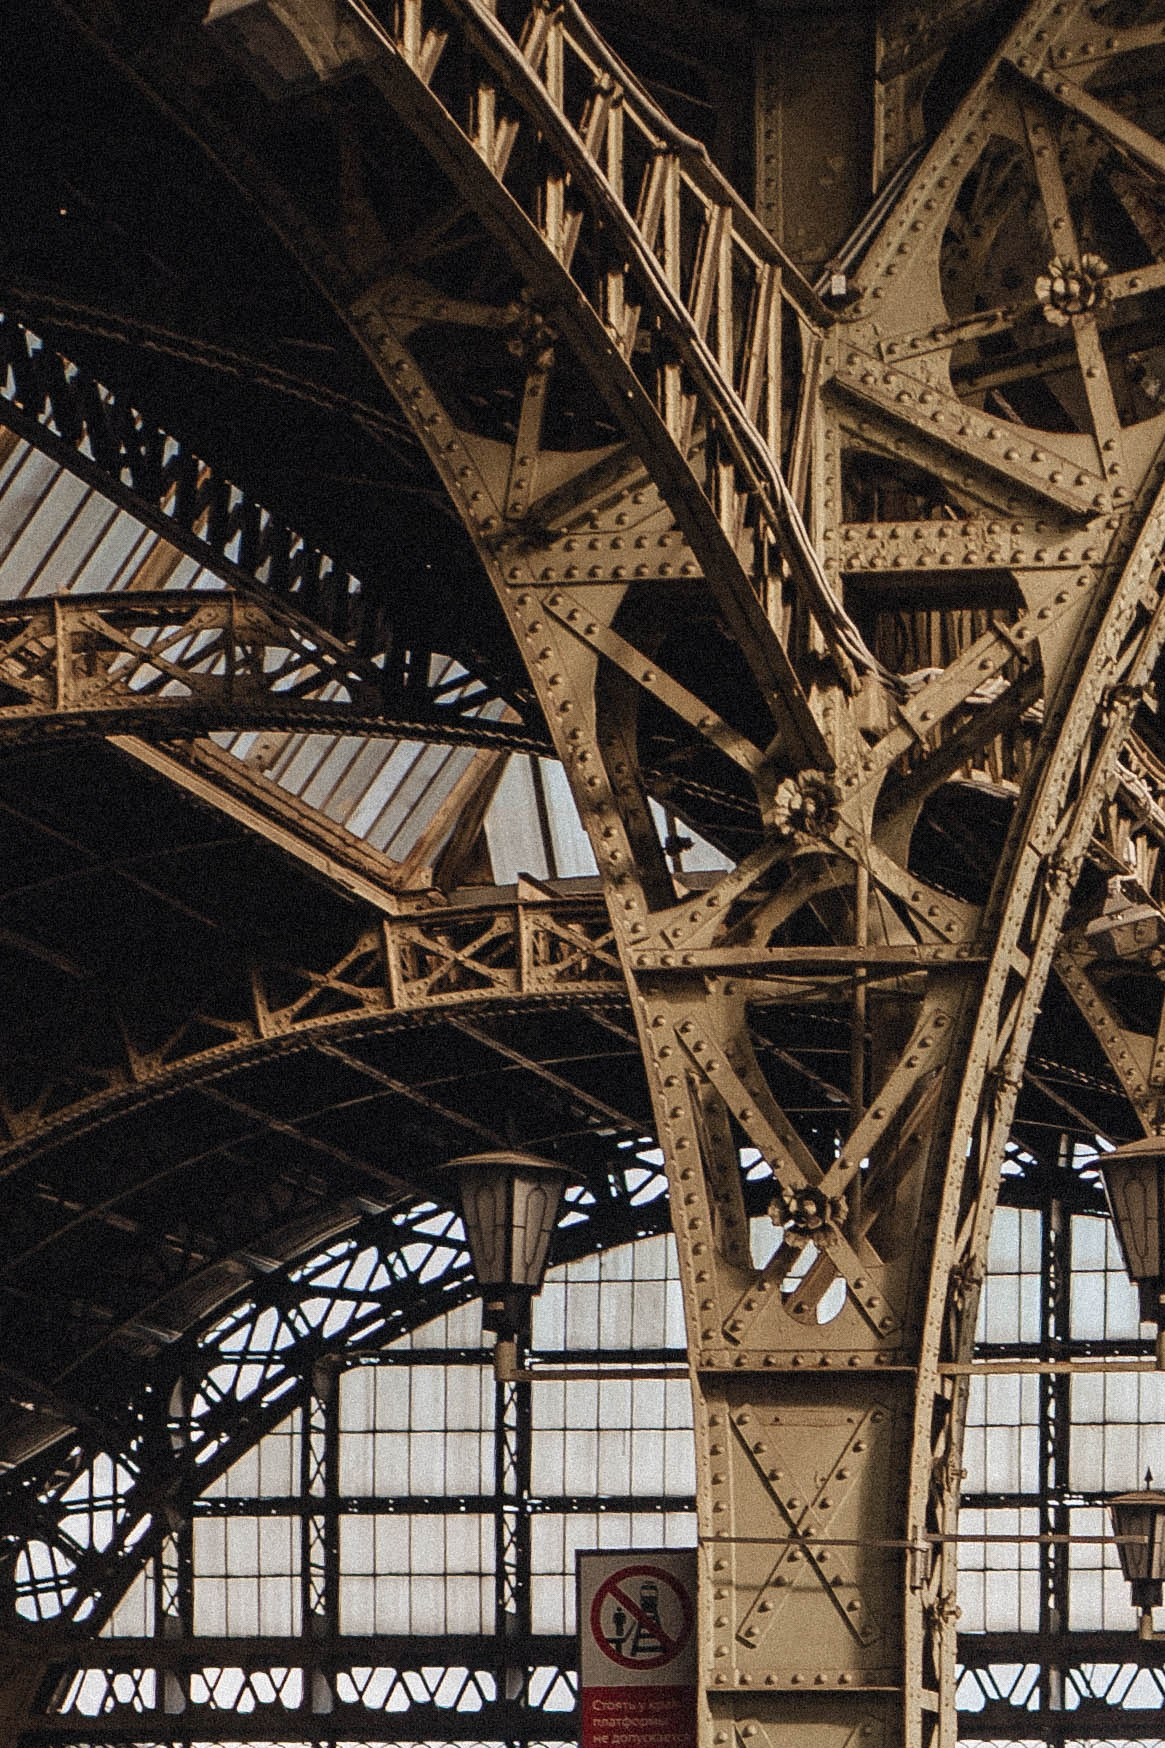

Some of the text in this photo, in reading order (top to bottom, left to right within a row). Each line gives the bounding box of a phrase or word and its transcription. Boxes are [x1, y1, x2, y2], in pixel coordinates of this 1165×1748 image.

[592, 1699, 636, 1711] Стоять
[592, 1717, 669, 1729] платформы
[592, 1734, 609, 1744] не
